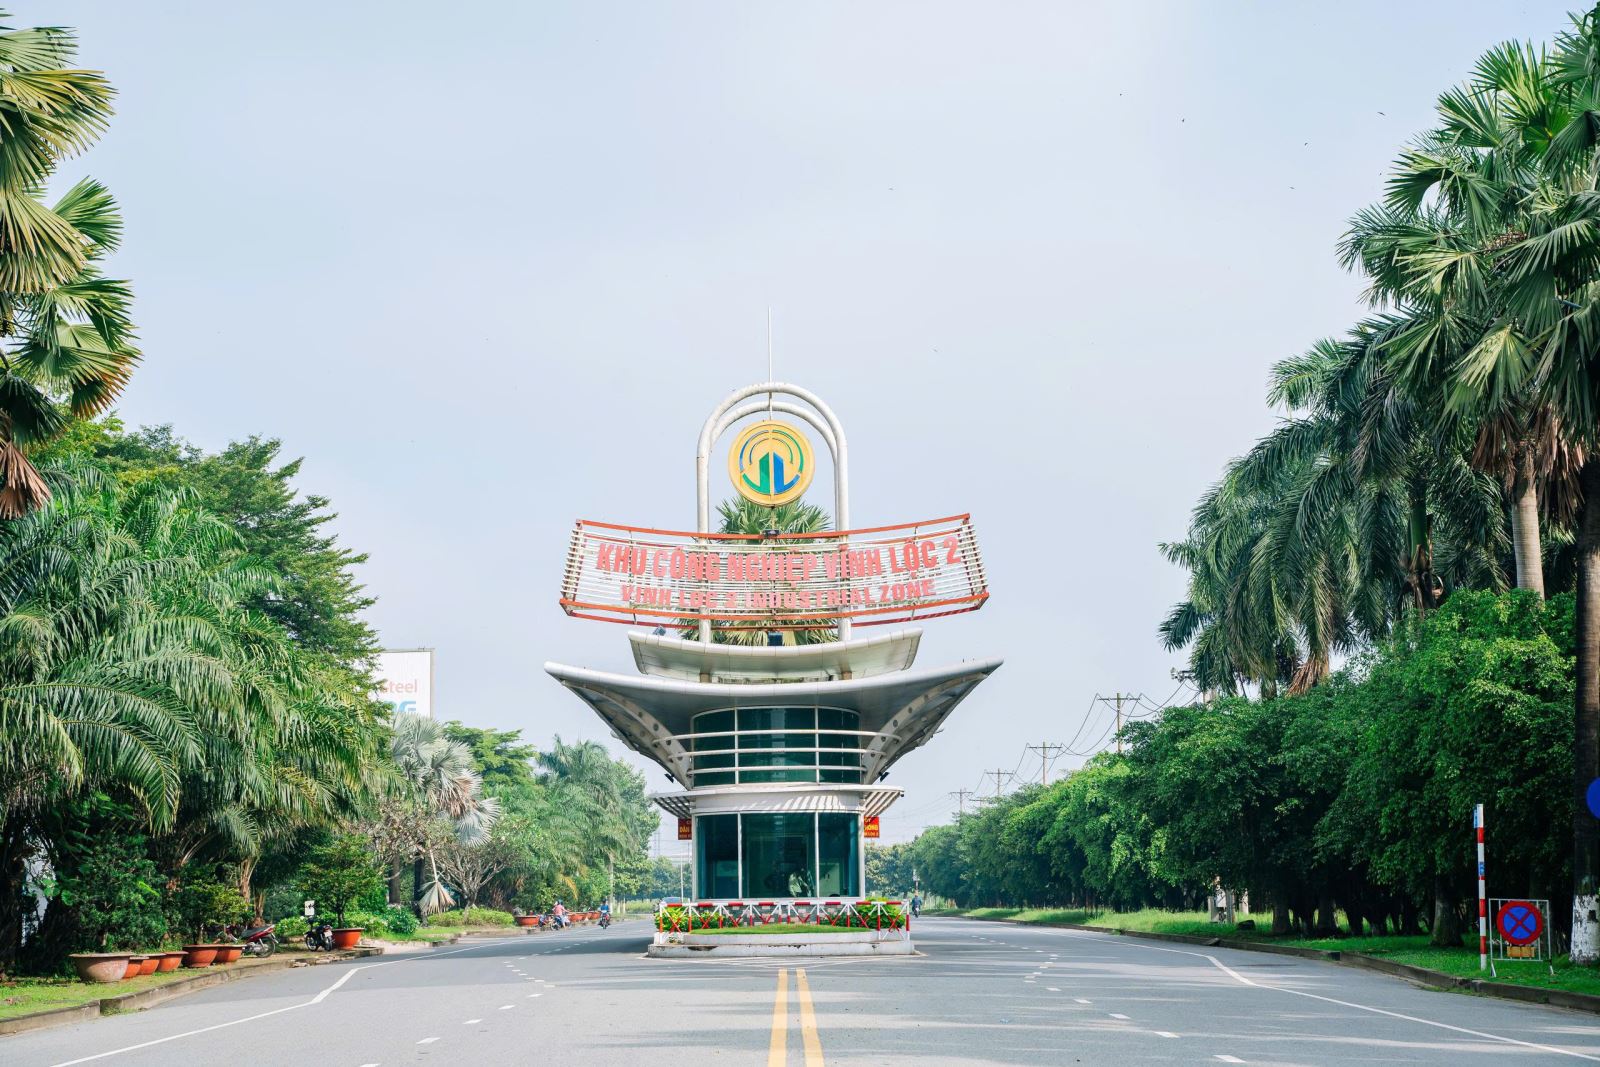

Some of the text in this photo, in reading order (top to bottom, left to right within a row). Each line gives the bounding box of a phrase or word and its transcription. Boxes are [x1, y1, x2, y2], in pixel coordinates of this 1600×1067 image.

[596, 543, 647, 576] KHU
[653, 546, 720, 581] CÔNG
[728, 547, 817, 589] NGHIỆP
[889, 538, 937, 579] LỘC
[943, 537, 962, 565] 2
[621, 584, 672, 605] VINH
[679, 589, 717, 608] LOC
[746, 587, 877, 609] INDUSTRIAL
[879, 579, 937, 603] ZONE
